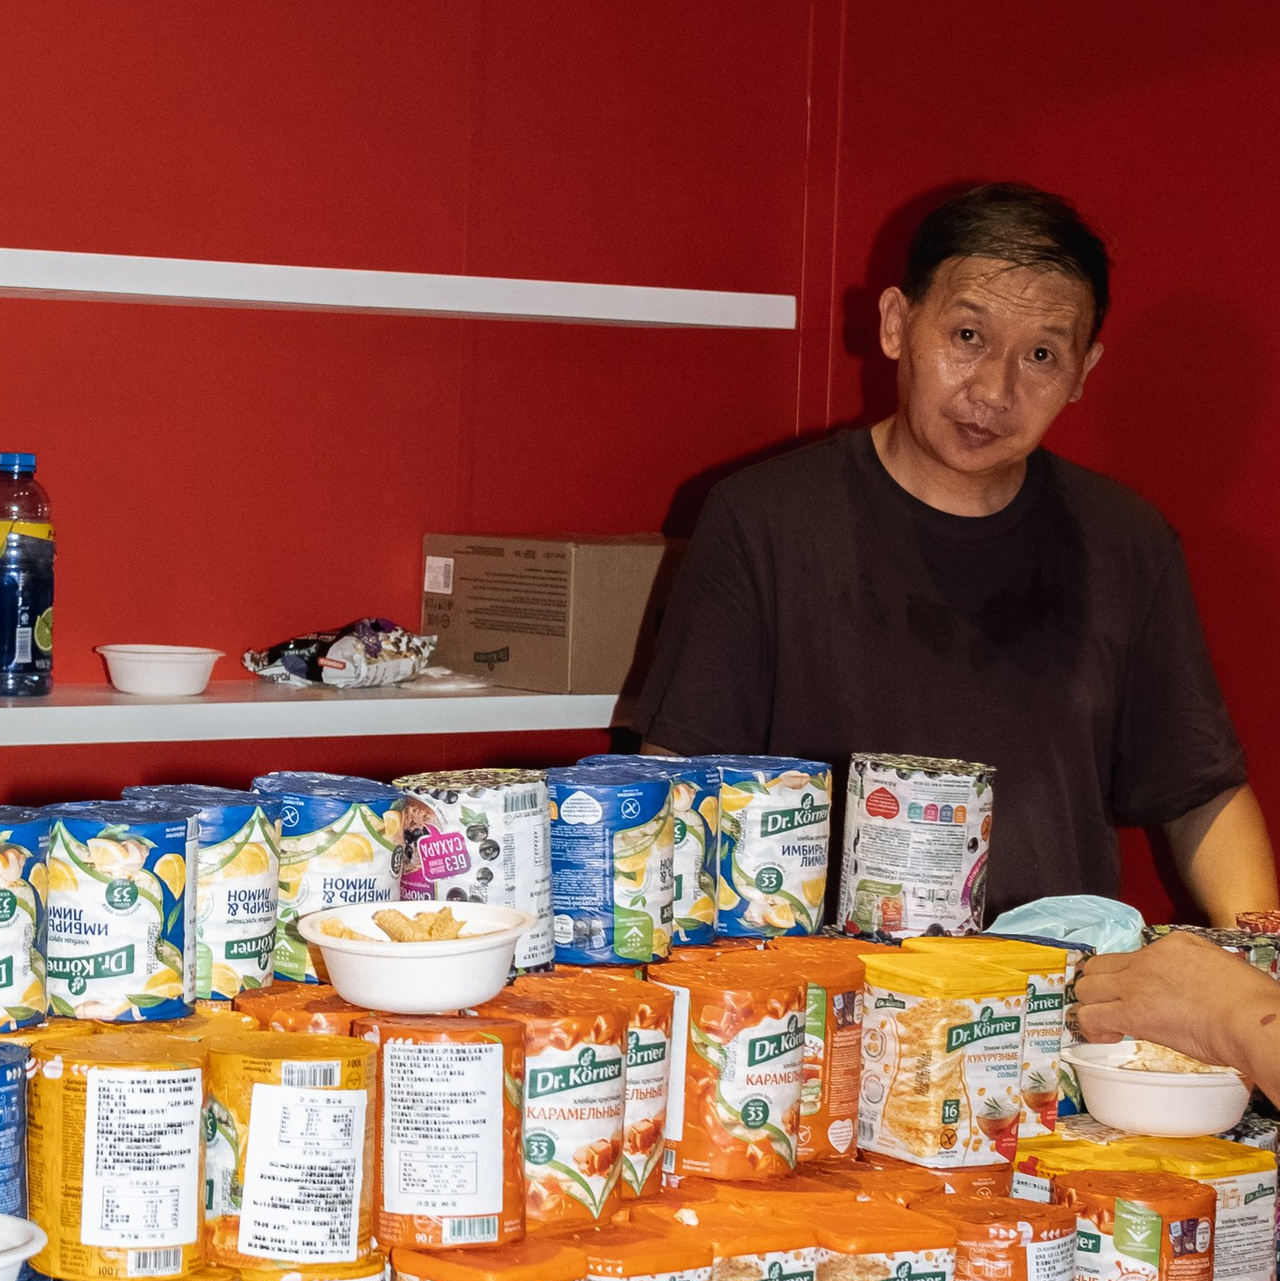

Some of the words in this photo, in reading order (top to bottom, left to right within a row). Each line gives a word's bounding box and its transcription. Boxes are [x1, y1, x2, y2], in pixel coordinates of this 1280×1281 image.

[767, 813, 791, 833] Dr.
[445, 854, 467, 872] БЕЗ
[323, 878, 377, 891] ЛИМОН
[761, 874, 777, 887] 33
[113, 887, 131, 901] 33
[228, 888, 271, 902] ЛИМОН
[323, 890, 335, 904] &
[340, 888, 391, 904] ИМБИРЬ
[49, 906, 83, 921] ЛИМ
[228, 902, 239, 916] &
[47, 959, 95, 976] Körne
[98, 951, 127, 972] Dr.
[951, 1028, 970, 1047] Dr.
[973, 1020, 1018, 1039] Körner
[626, 1046, 665, 1066] örner
[754, 1040, 779, 1061] Dr.
[967, 1051, 1019, 1064] КУКУРУЗНЫЕ
[536, 1072, 566, 1093] Dr.
[569, 1063, 620, 1085] Körner
[526, 1103, 621, 1120] КАРАМЕЛЬНЫЕ
[747, 1107, 764, 1121] 33
[944, 1104, 958, 1119] 16
[529, 1140, 548, 1157] 33
[415, 1233, 427, 1243] 90
